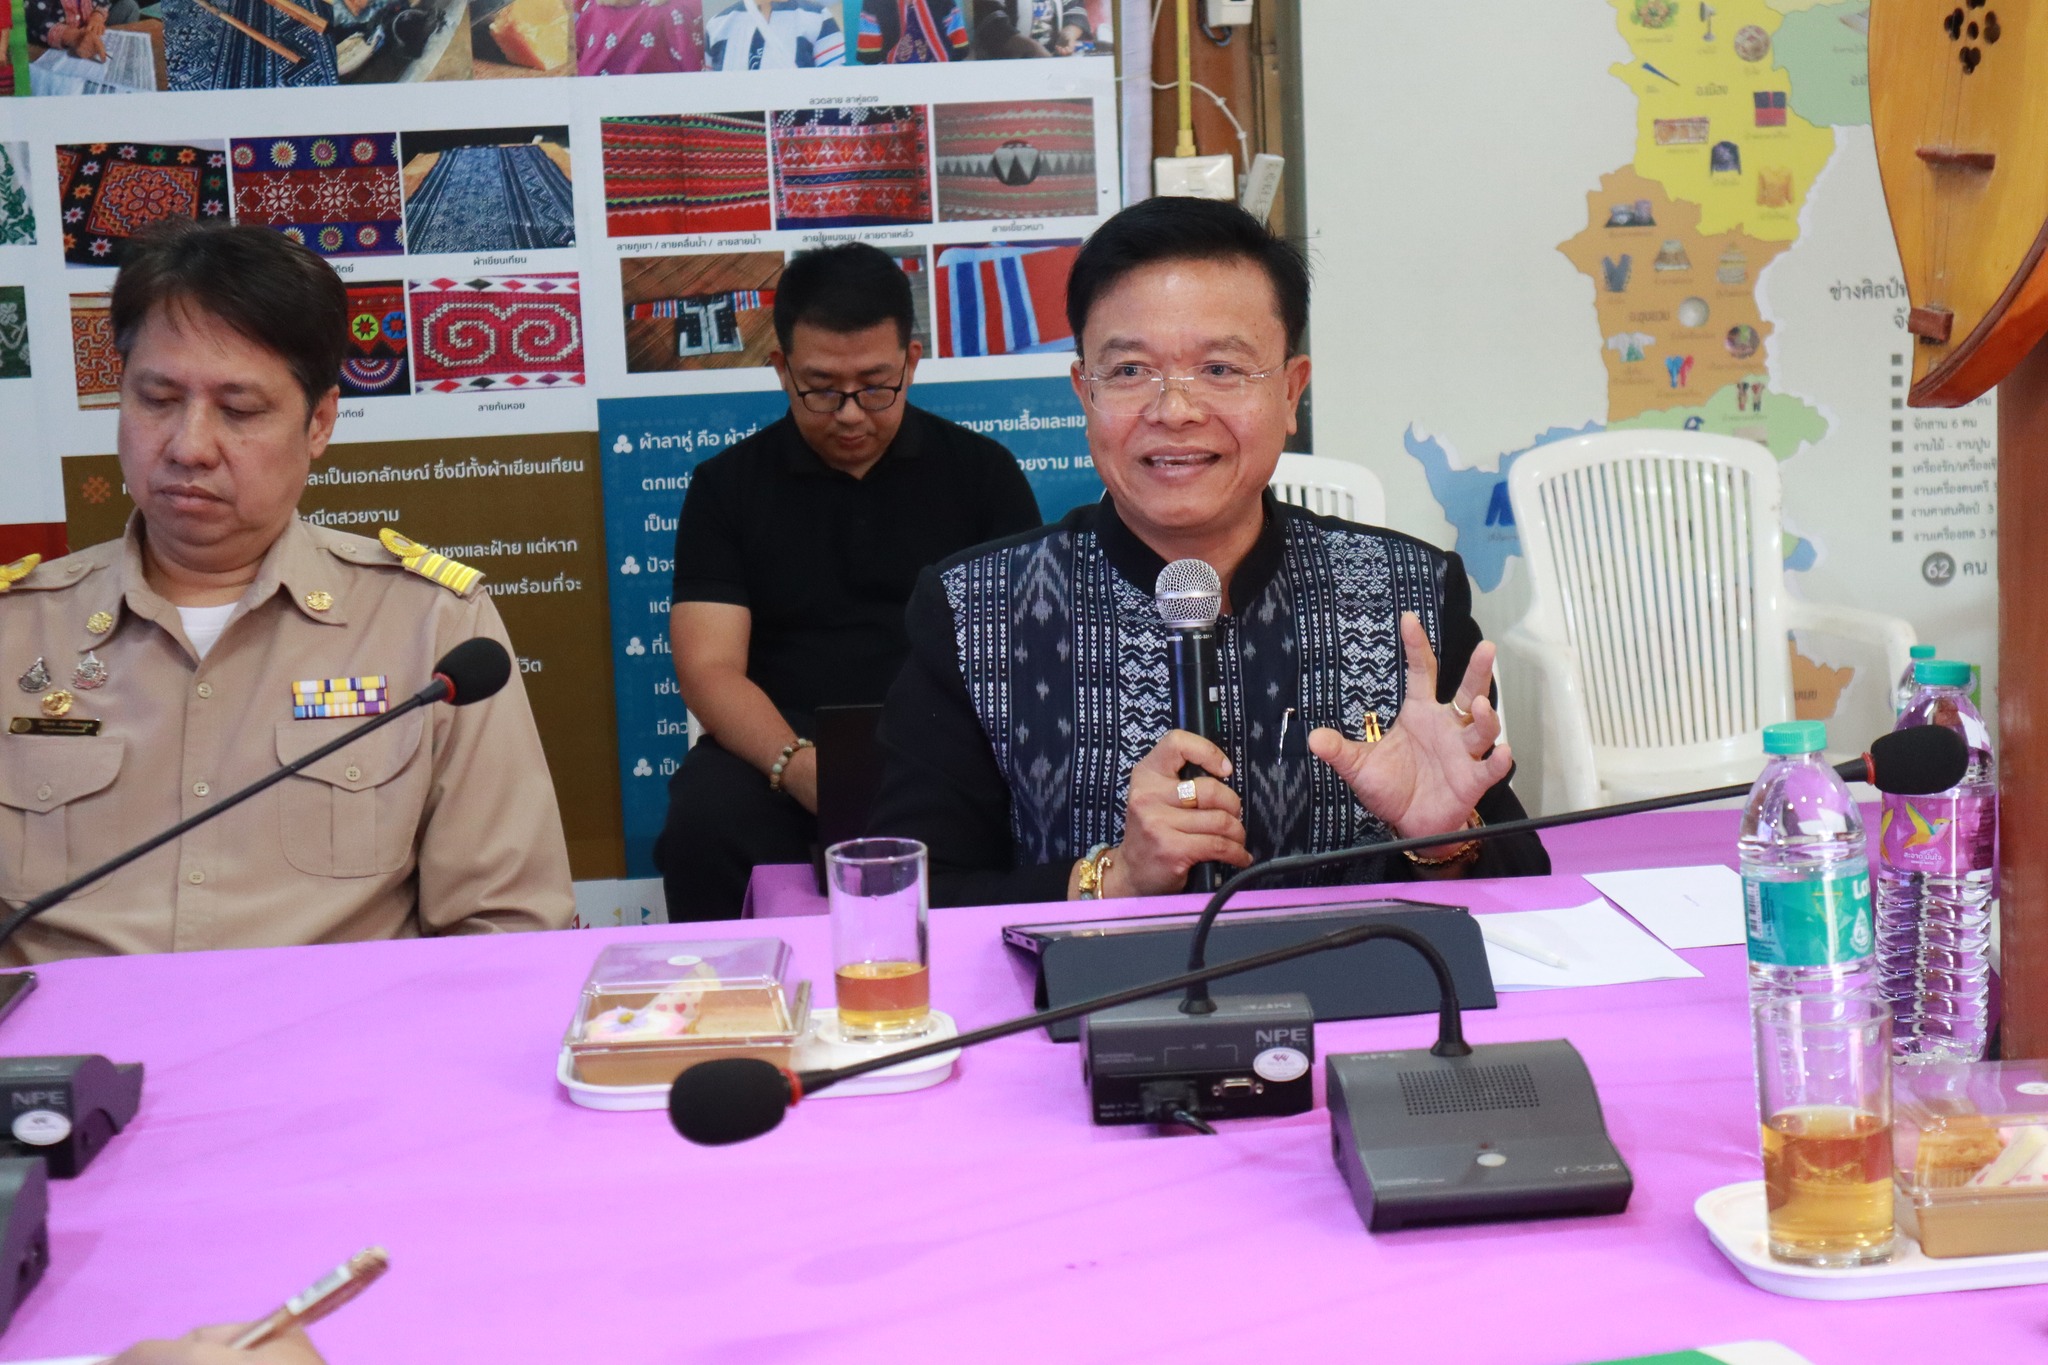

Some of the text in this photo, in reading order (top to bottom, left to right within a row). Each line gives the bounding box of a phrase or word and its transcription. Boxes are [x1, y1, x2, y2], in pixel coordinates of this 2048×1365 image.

[992, 221, 1044, 233] ลายเขี้ยวหมา
[616, 241, 653, 253] ลายภูเขา
[661, 235, 707, 249] ลายคลื่นน้ำ
[717, 233, 761, 246] ลายสายน้ำ
[473, 254, 527, 266] ผ้าเขียนเทียน
[478, 401, 525, 412] ลายก้นหอย
[639, 430, 693, 452] ผ้าลาหู่
[697, 428, 720, 446] คือ
[955, 409, 1087, 433] อบชายเสื้อและแข
[304, 456, 584, 486] ละเป็นเอกลักษณ์ ซึ่งมีทั้งผ้าเขียนเทียน
[642, 471, 692, 491] ตกแต่
[526, 538, 577, 555] แต่หาก
[1926, 561, 1987, 579] 62 คน
[659, 757, 679, 776] เป็
[1255, 1027, 1308, 1043] NPE
[11, 1090, 66, 1107] NPE
